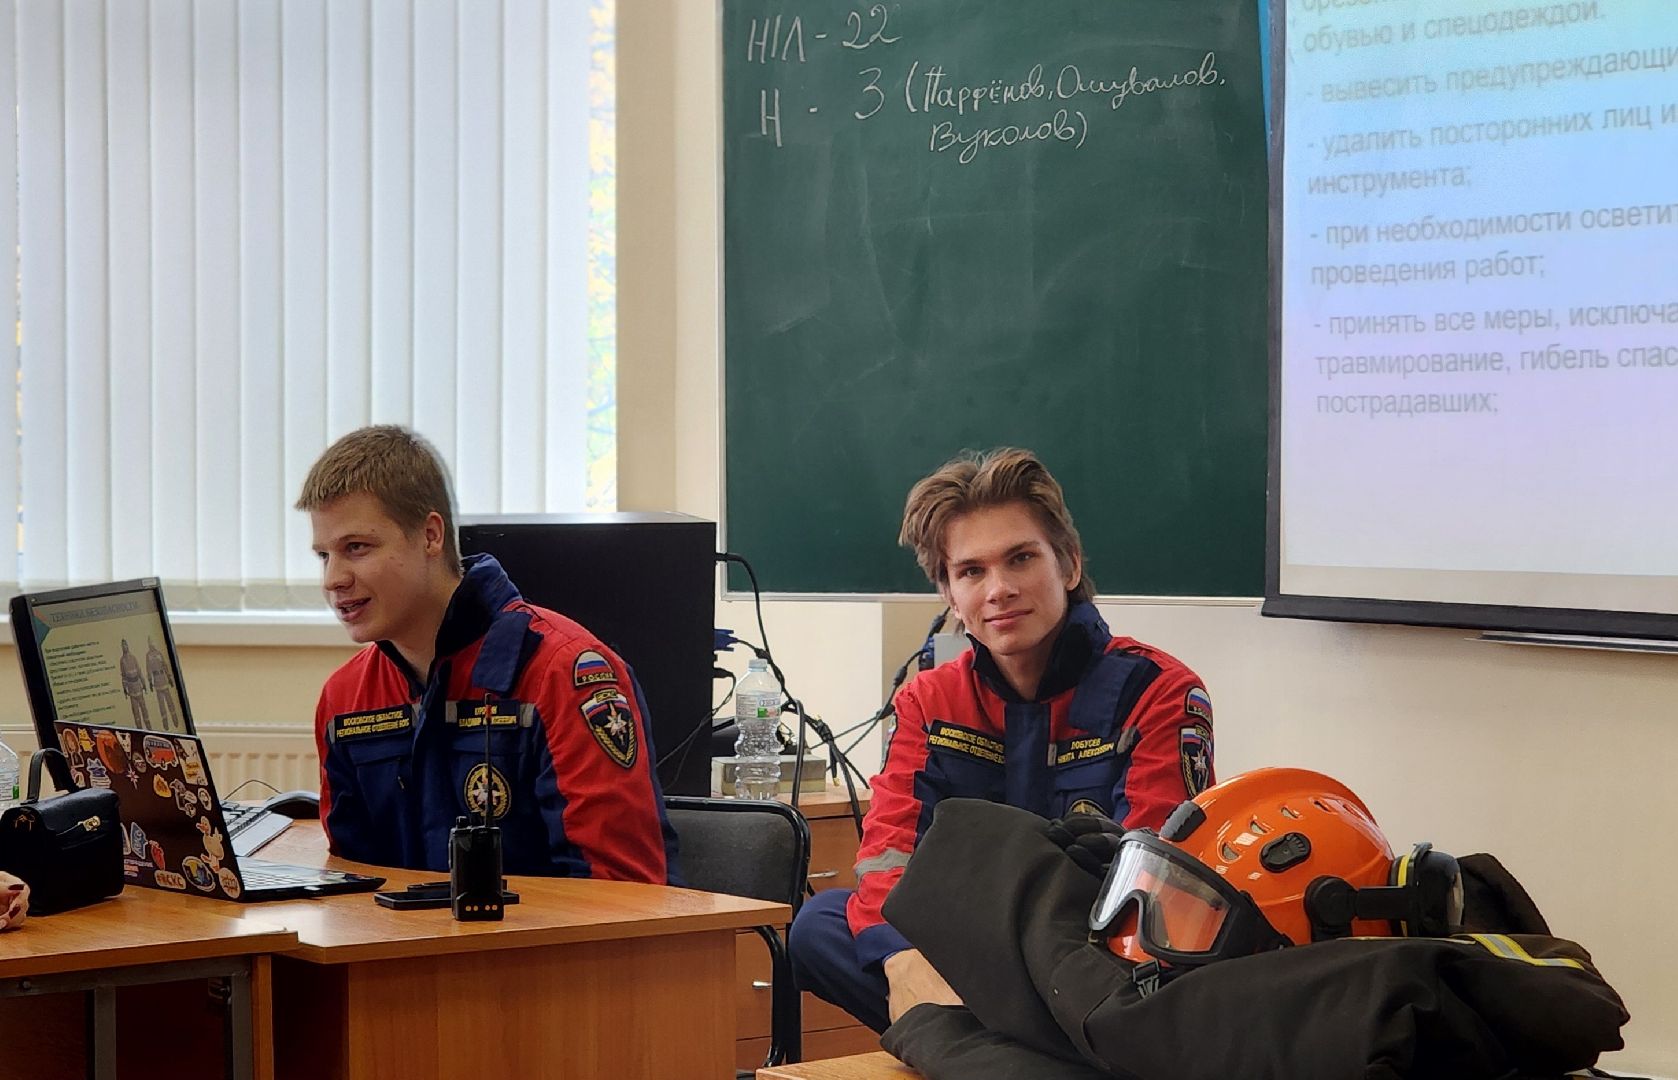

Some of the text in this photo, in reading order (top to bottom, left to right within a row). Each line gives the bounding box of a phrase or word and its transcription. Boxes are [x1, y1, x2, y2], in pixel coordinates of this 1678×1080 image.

[841, 4, 902, 50] 22
[1303, 24, 1393, 56] обувью
[1401, 21, 1416, 43] и
[1423, 3, 1606, 41] спецодеждой.
[1321, 71, 1437, 102] вывесить
[761, 88, 783, 147] Н
[854, 67, 885, 120] 3
[1323, 126, 1422, 160] удалить
[1430, 110, 1592, 148] посторонних
[1602, 105, 1653, 131] лиц
[1308, 164, 1472, 198] инструмента;
[1326, 222, 1369, 249] при
[1377, 210, 1571, 243] необходимости
[1311, 250, 1545, 289] проведения работ;
[1329, 311, 1426, 340] принять
[1434, 310, 1474, 332] все
[1483, 305, 1560, 335] меры,
[1315, 344, 1678, 379] травмирование, гибель спас
[1316, 391, 1499, 417] пострадавших;
